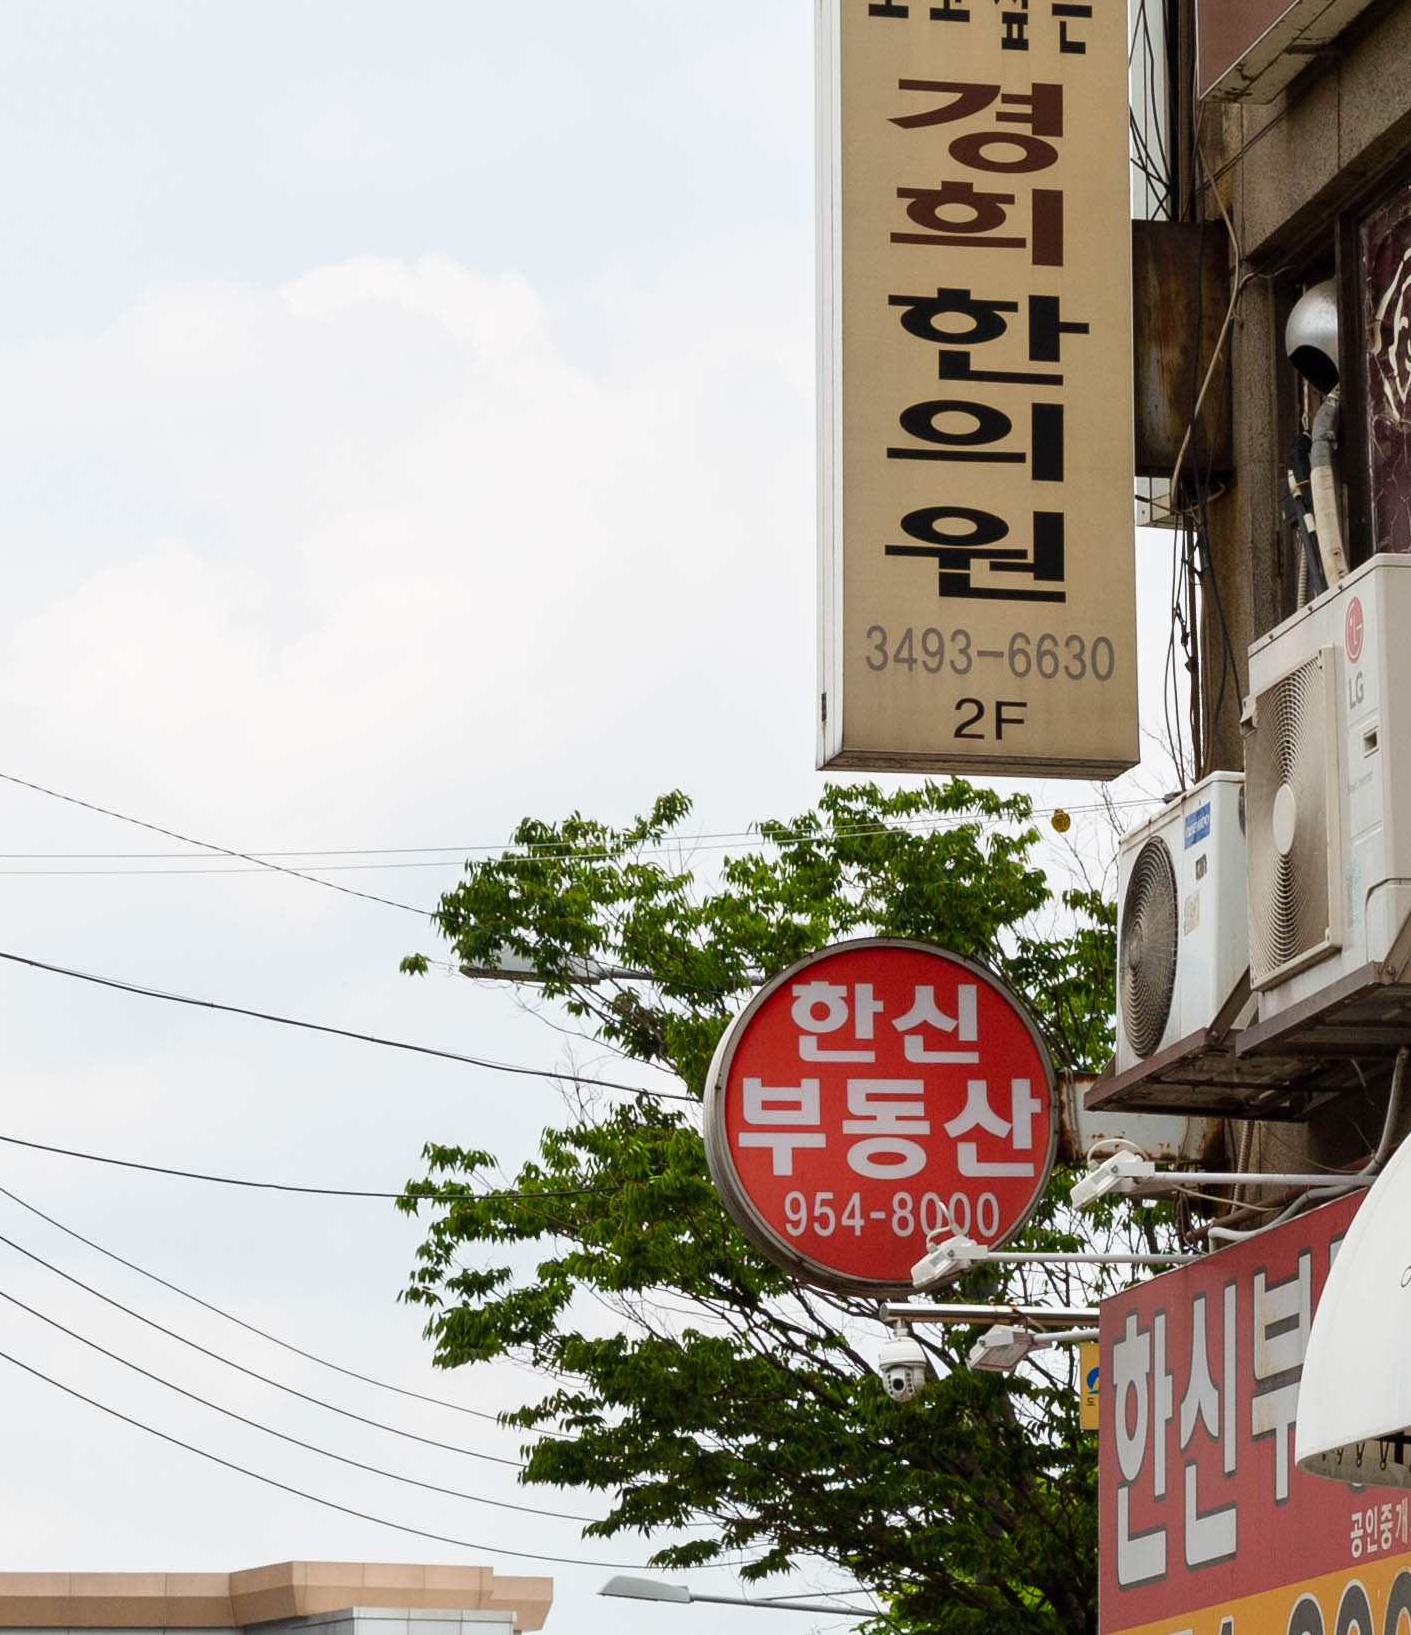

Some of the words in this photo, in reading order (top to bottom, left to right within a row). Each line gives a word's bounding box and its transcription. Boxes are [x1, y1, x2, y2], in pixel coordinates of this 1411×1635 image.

[864, 624, 1116, 682] 3493-6630
[1349, 670, 1364, 710] LG
[953, 697, 1028, 741] 2F
[790, 980, 980, 1064] 한신
[738, 1077, 1043, 1181] 부동산
[784, 1191, 1000, 1239] 954-8000
